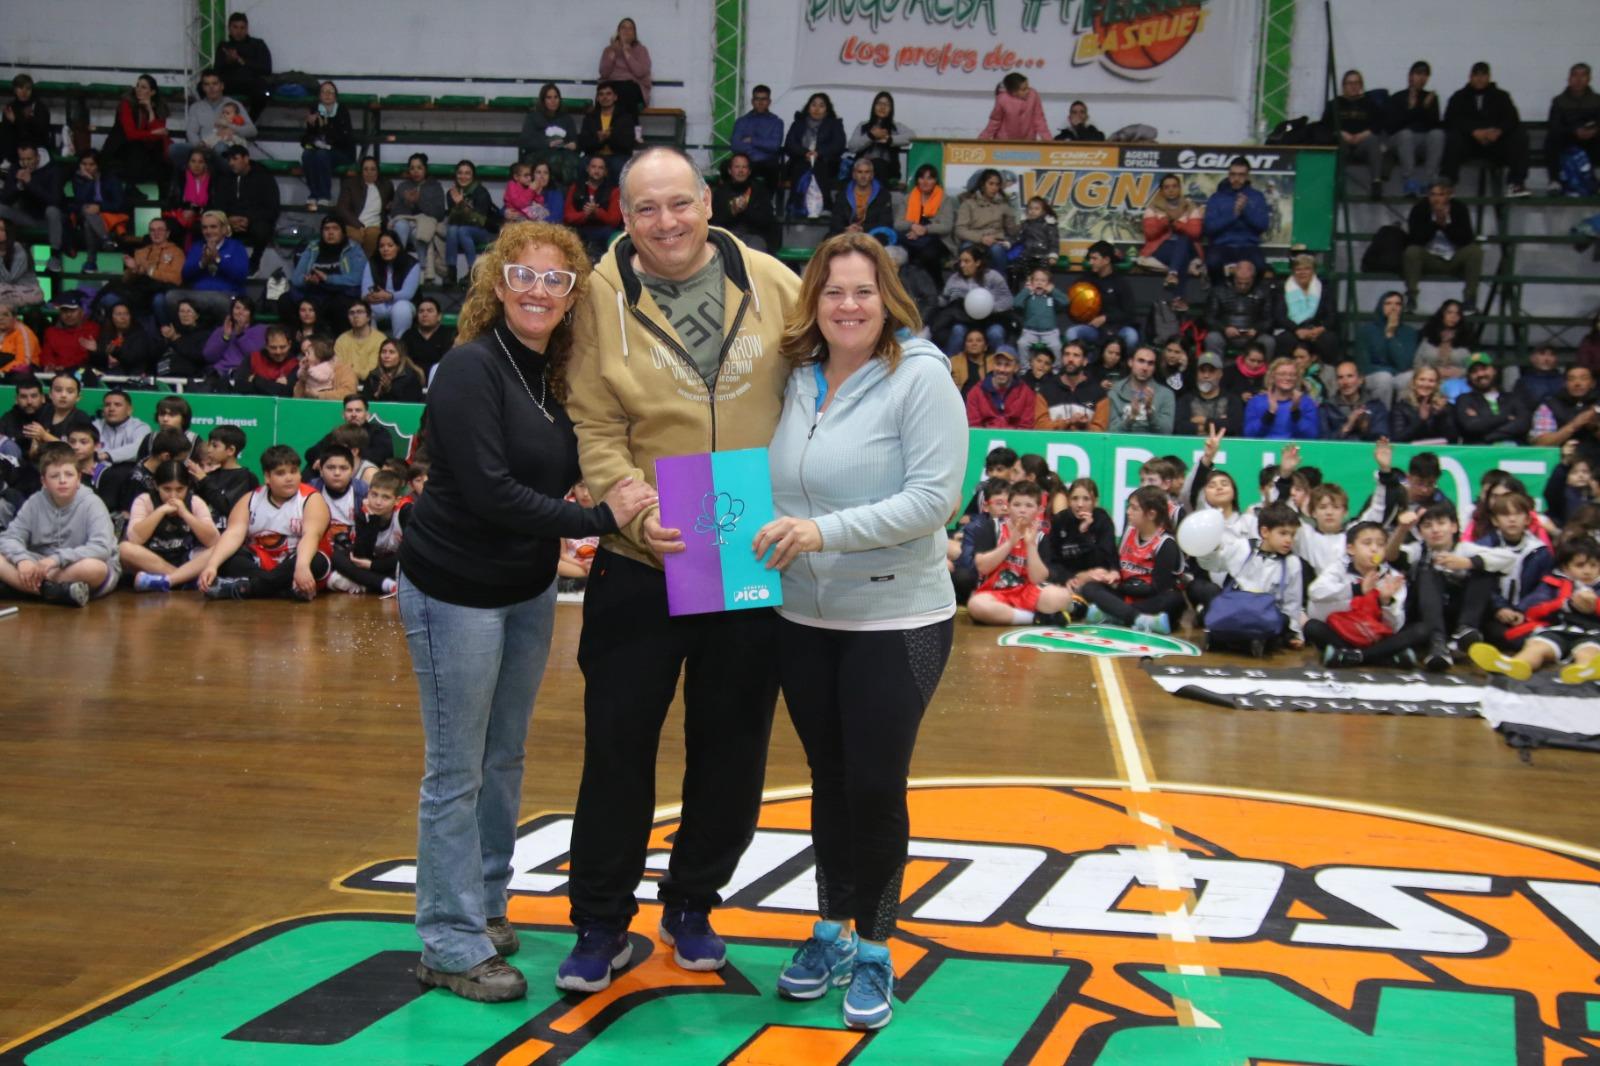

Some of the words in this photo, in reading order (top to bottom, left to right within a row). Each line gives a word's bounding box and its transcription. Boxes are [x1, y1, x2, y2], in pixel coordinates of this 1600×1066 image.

[841, 36, 890, 65] Los
[896, 44, 978, 74] profes
[1125, 150, 1161, 159] AGENTE
[1124, 159, 1160, 168] OFICIAL
[1022, 171, 1155, 208] VIGN
[191, 417, 214, 425] erro
[733, 589, 770, 602] PICO
